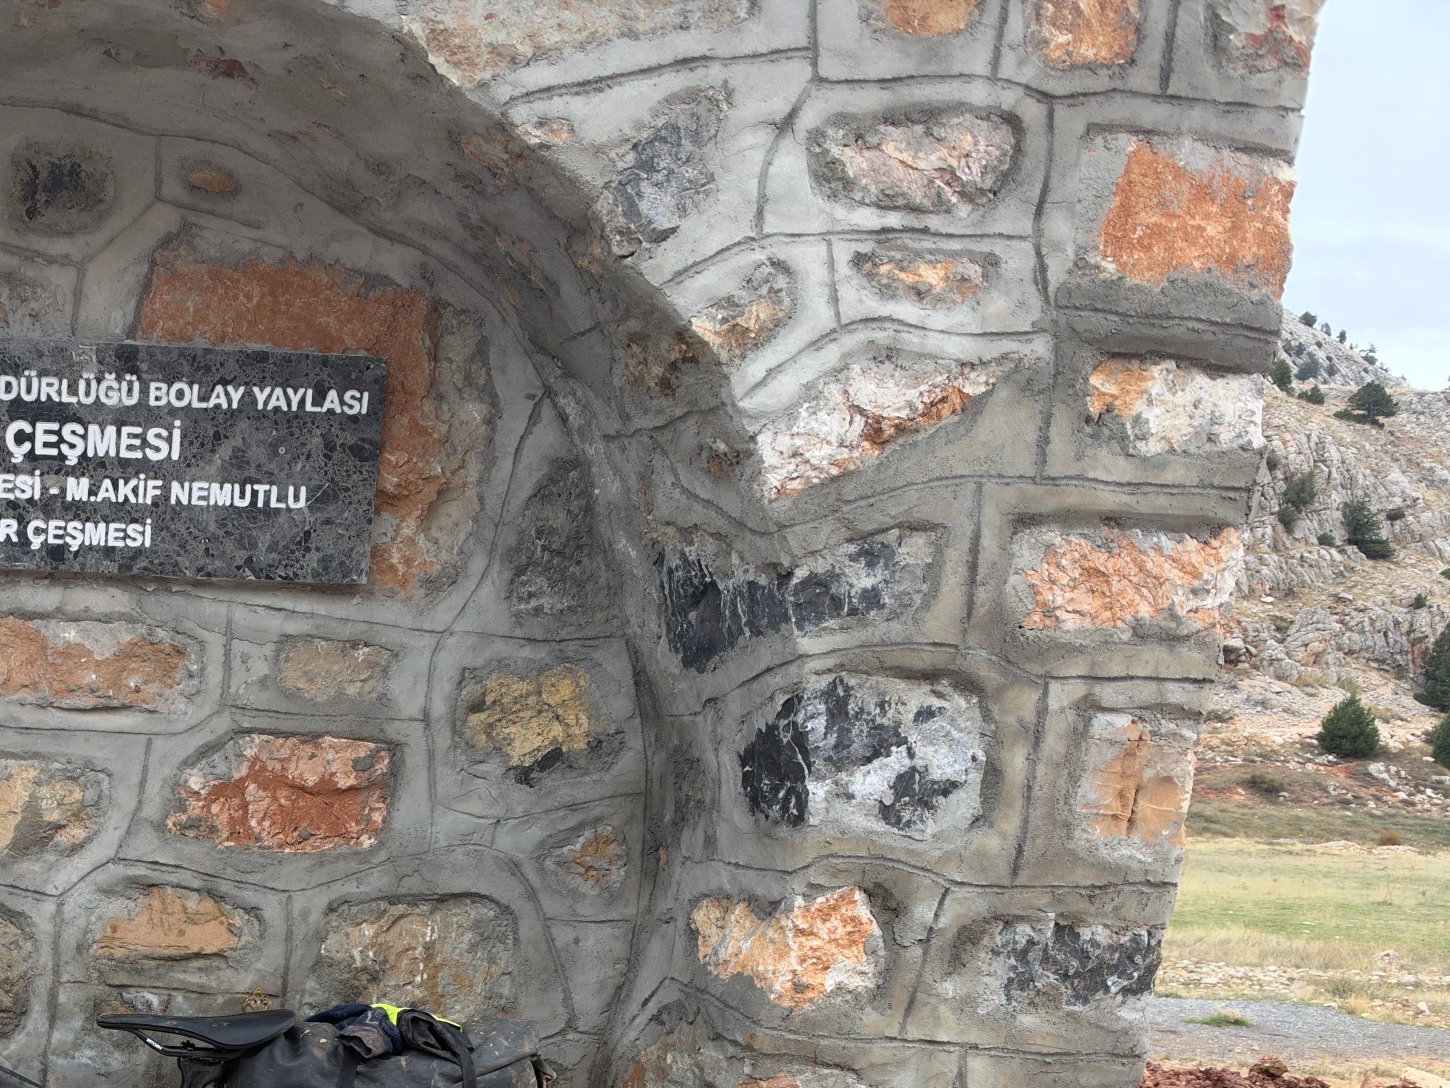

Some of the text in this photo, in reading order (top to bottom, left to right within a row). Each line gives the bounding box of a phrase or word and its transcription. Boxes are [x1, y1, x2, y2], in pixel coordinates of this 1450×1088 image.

[148, 381, 245, 410] BOLAY
[252, 386, 369, 415] YAYLASI
[5, 419, 182, 466] ÇEŞMESİ
[65, 473, 163, 505] M.AKİF
[170, 480, 307, 510] NEMUTLU
[26, 517, 152, 551] ÇEŞMESİ
